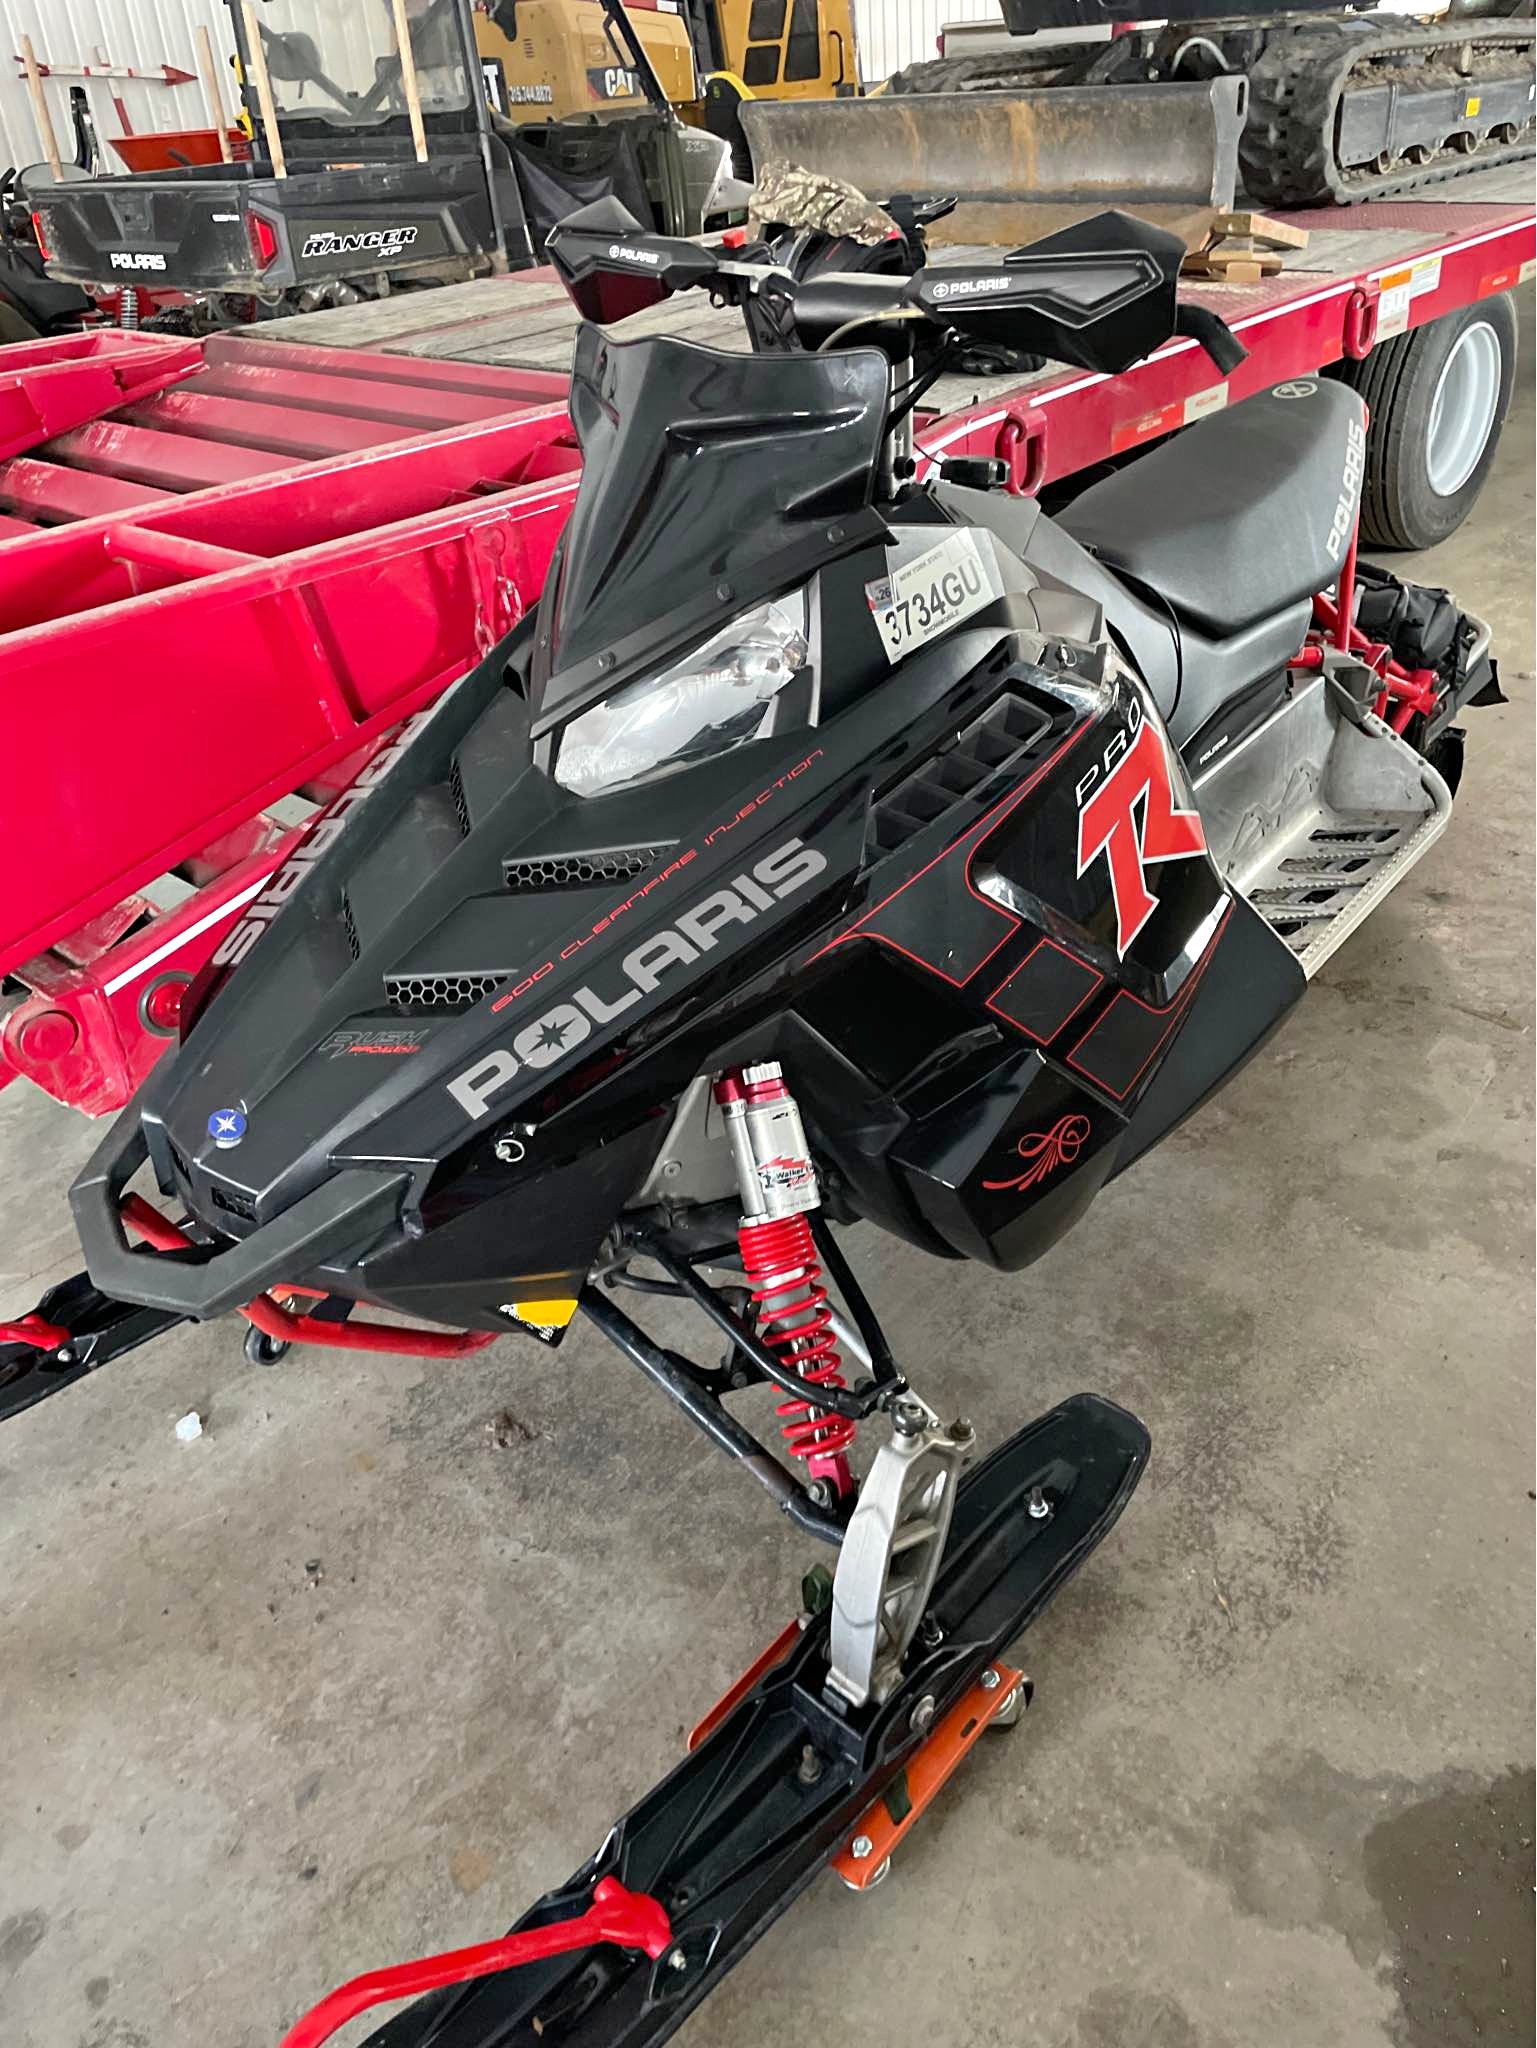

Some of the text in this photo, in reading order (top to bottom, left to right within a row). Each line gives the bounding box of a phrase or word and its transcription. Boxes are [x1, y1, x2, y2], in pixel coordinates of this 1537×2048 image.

[604, 68, 634, 98] CAT
[302, 226, 418, 258] RANGER
[378, 245, 402, 258] XP
[620, 247, 660, 264] POLARIS
[110, 252, 167, 270] POLARIS
[950, 276, 1009, 295] POLARIS
[1326, 418, 1364, 561] POLARIS
[885, 559, 982, 645] 3734GU
[1075, 696, 1141, 807] PRO
[1200, 735, 1228, 765] POLARIS
[212, 711, 433, 966] POLARIS
[490, 748, 823, 1014] 600 CLEANFIRE INJECTION
[446, 836, 828, 1121] POLARIS
[776, 1166, 804, 1180] Walker
